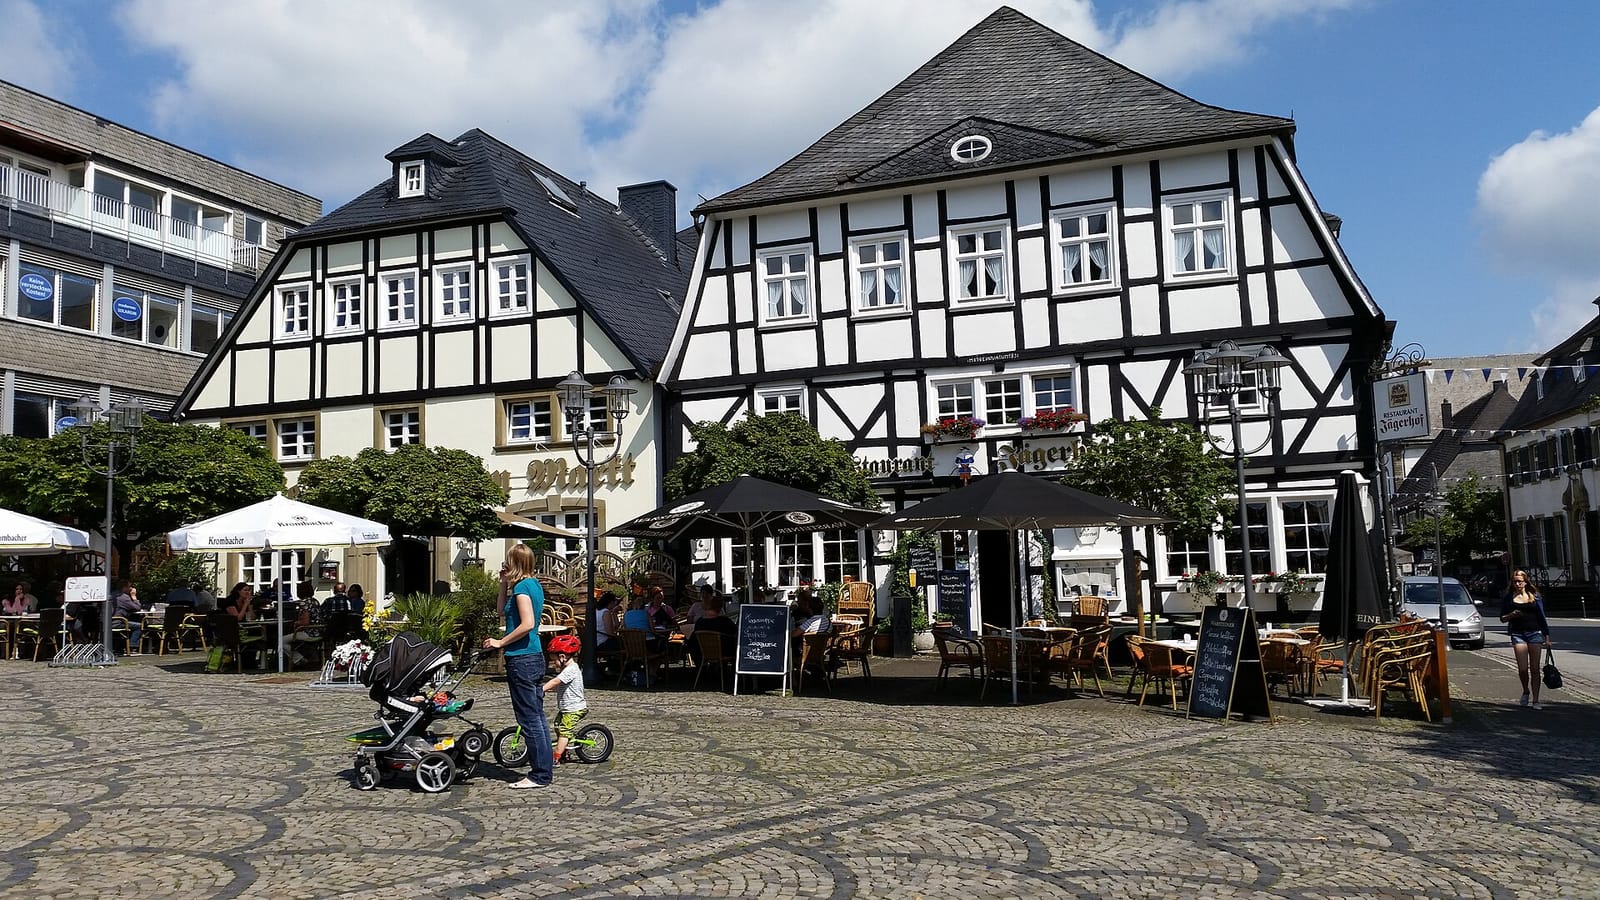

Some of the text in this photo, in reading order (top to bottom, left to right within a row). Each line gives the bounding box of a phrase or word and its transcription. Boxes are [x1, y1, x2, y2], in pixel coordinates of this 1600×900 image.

[1383, 407, 1418, 418] RESTAURANT
[1379, 413, 1425, 434] Jägerhof
[852, 454, 936, 475] staurant
[997, 439, 1088, 470] Jägerh
[526, 452, 636, 490] Markt
[0, 533, 27, 542] mbacher
[208, 535, 245, 545] Krombacher
